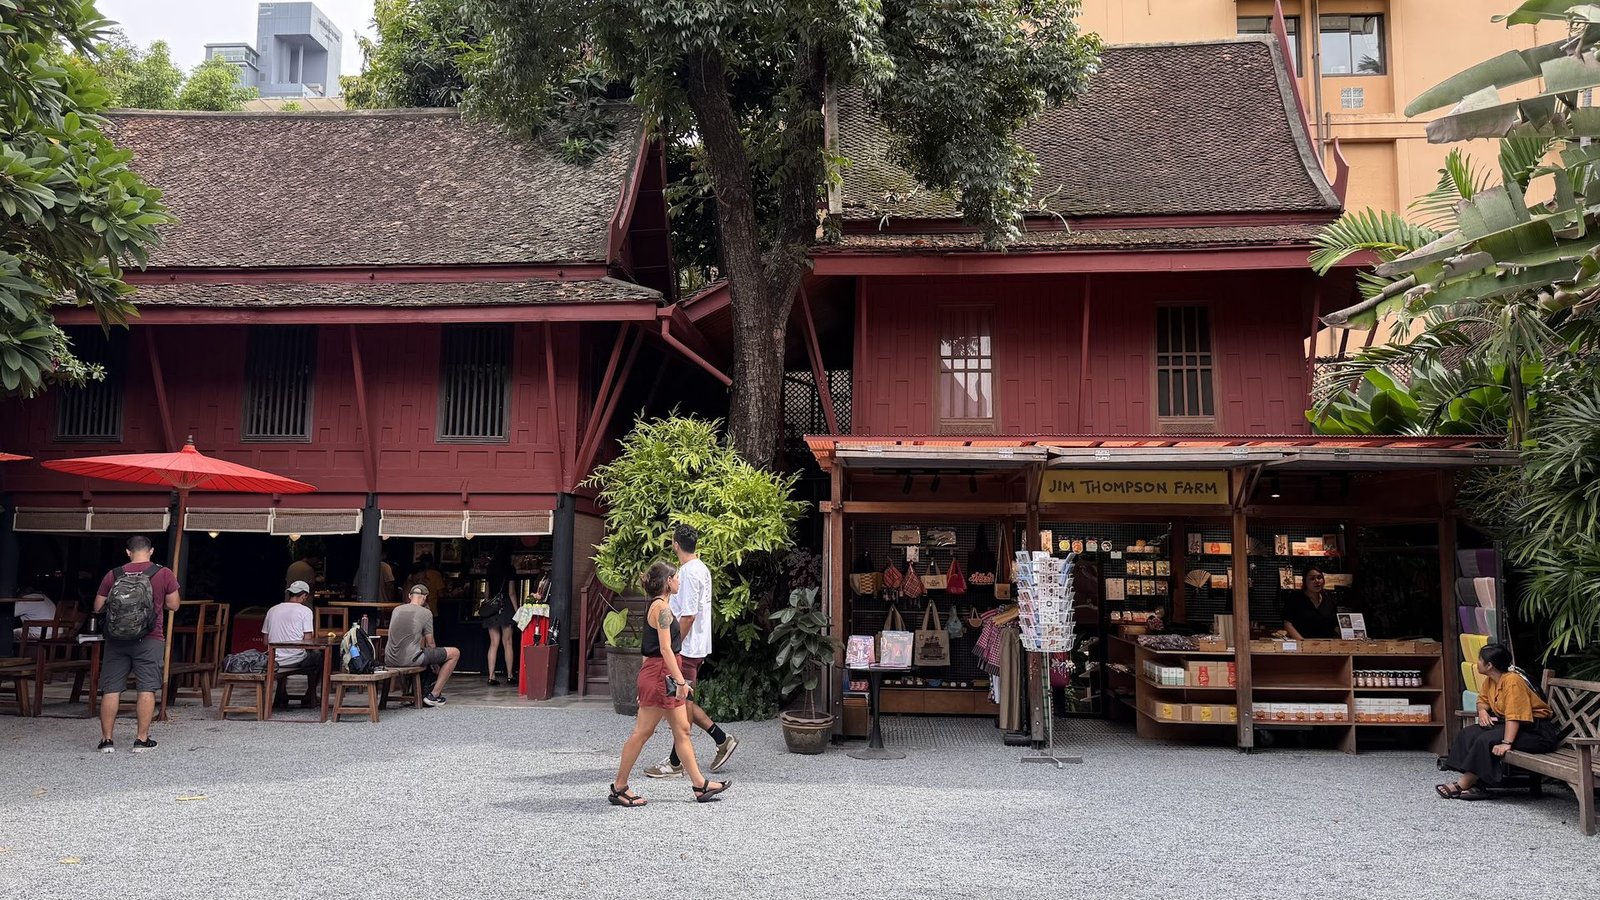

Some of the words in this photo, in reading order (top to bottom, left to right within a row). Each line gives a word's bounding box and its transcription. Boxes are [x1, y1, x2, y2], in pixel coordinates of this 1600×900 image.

[1049, 480, 1075, 493] JIM
[1080, 480, 1168, 494] THOMPSON
[1174, 481, 1218, 494] FARM
